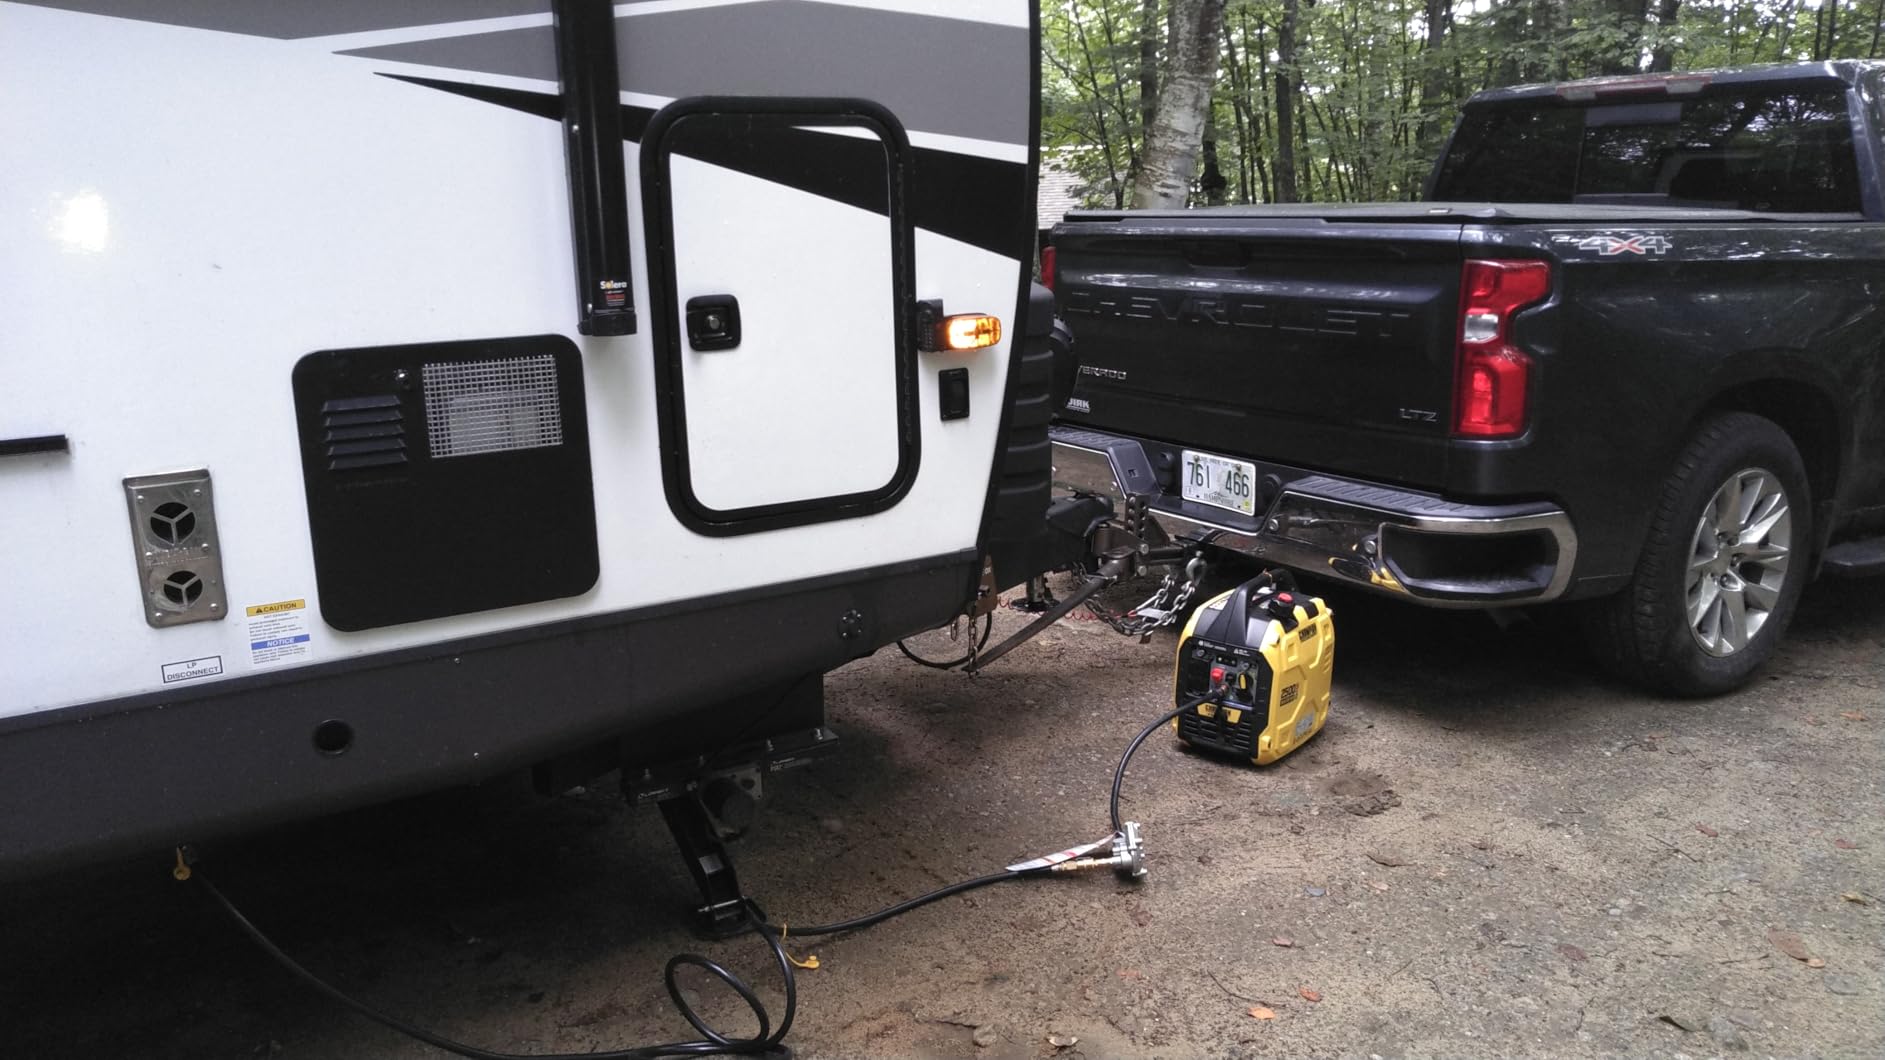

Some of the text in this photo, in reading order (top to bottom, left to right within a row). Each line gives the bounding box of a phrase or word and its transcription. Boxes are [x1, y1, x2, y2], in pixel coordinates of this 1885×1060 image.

[600, 280, 627, 289] Solera
[1078, 365, 1127, 380] ERADO
[1400, 408, 1437, 422] LTZ
[1187, 461, 1210, 488] 761
[1225, 470, 1249, 498] 466
[263, 602, 297, 613] CAUTION
[267, 637, 295, 647] NOTICE
[167, 666, 218, 680] DISCONNECT
